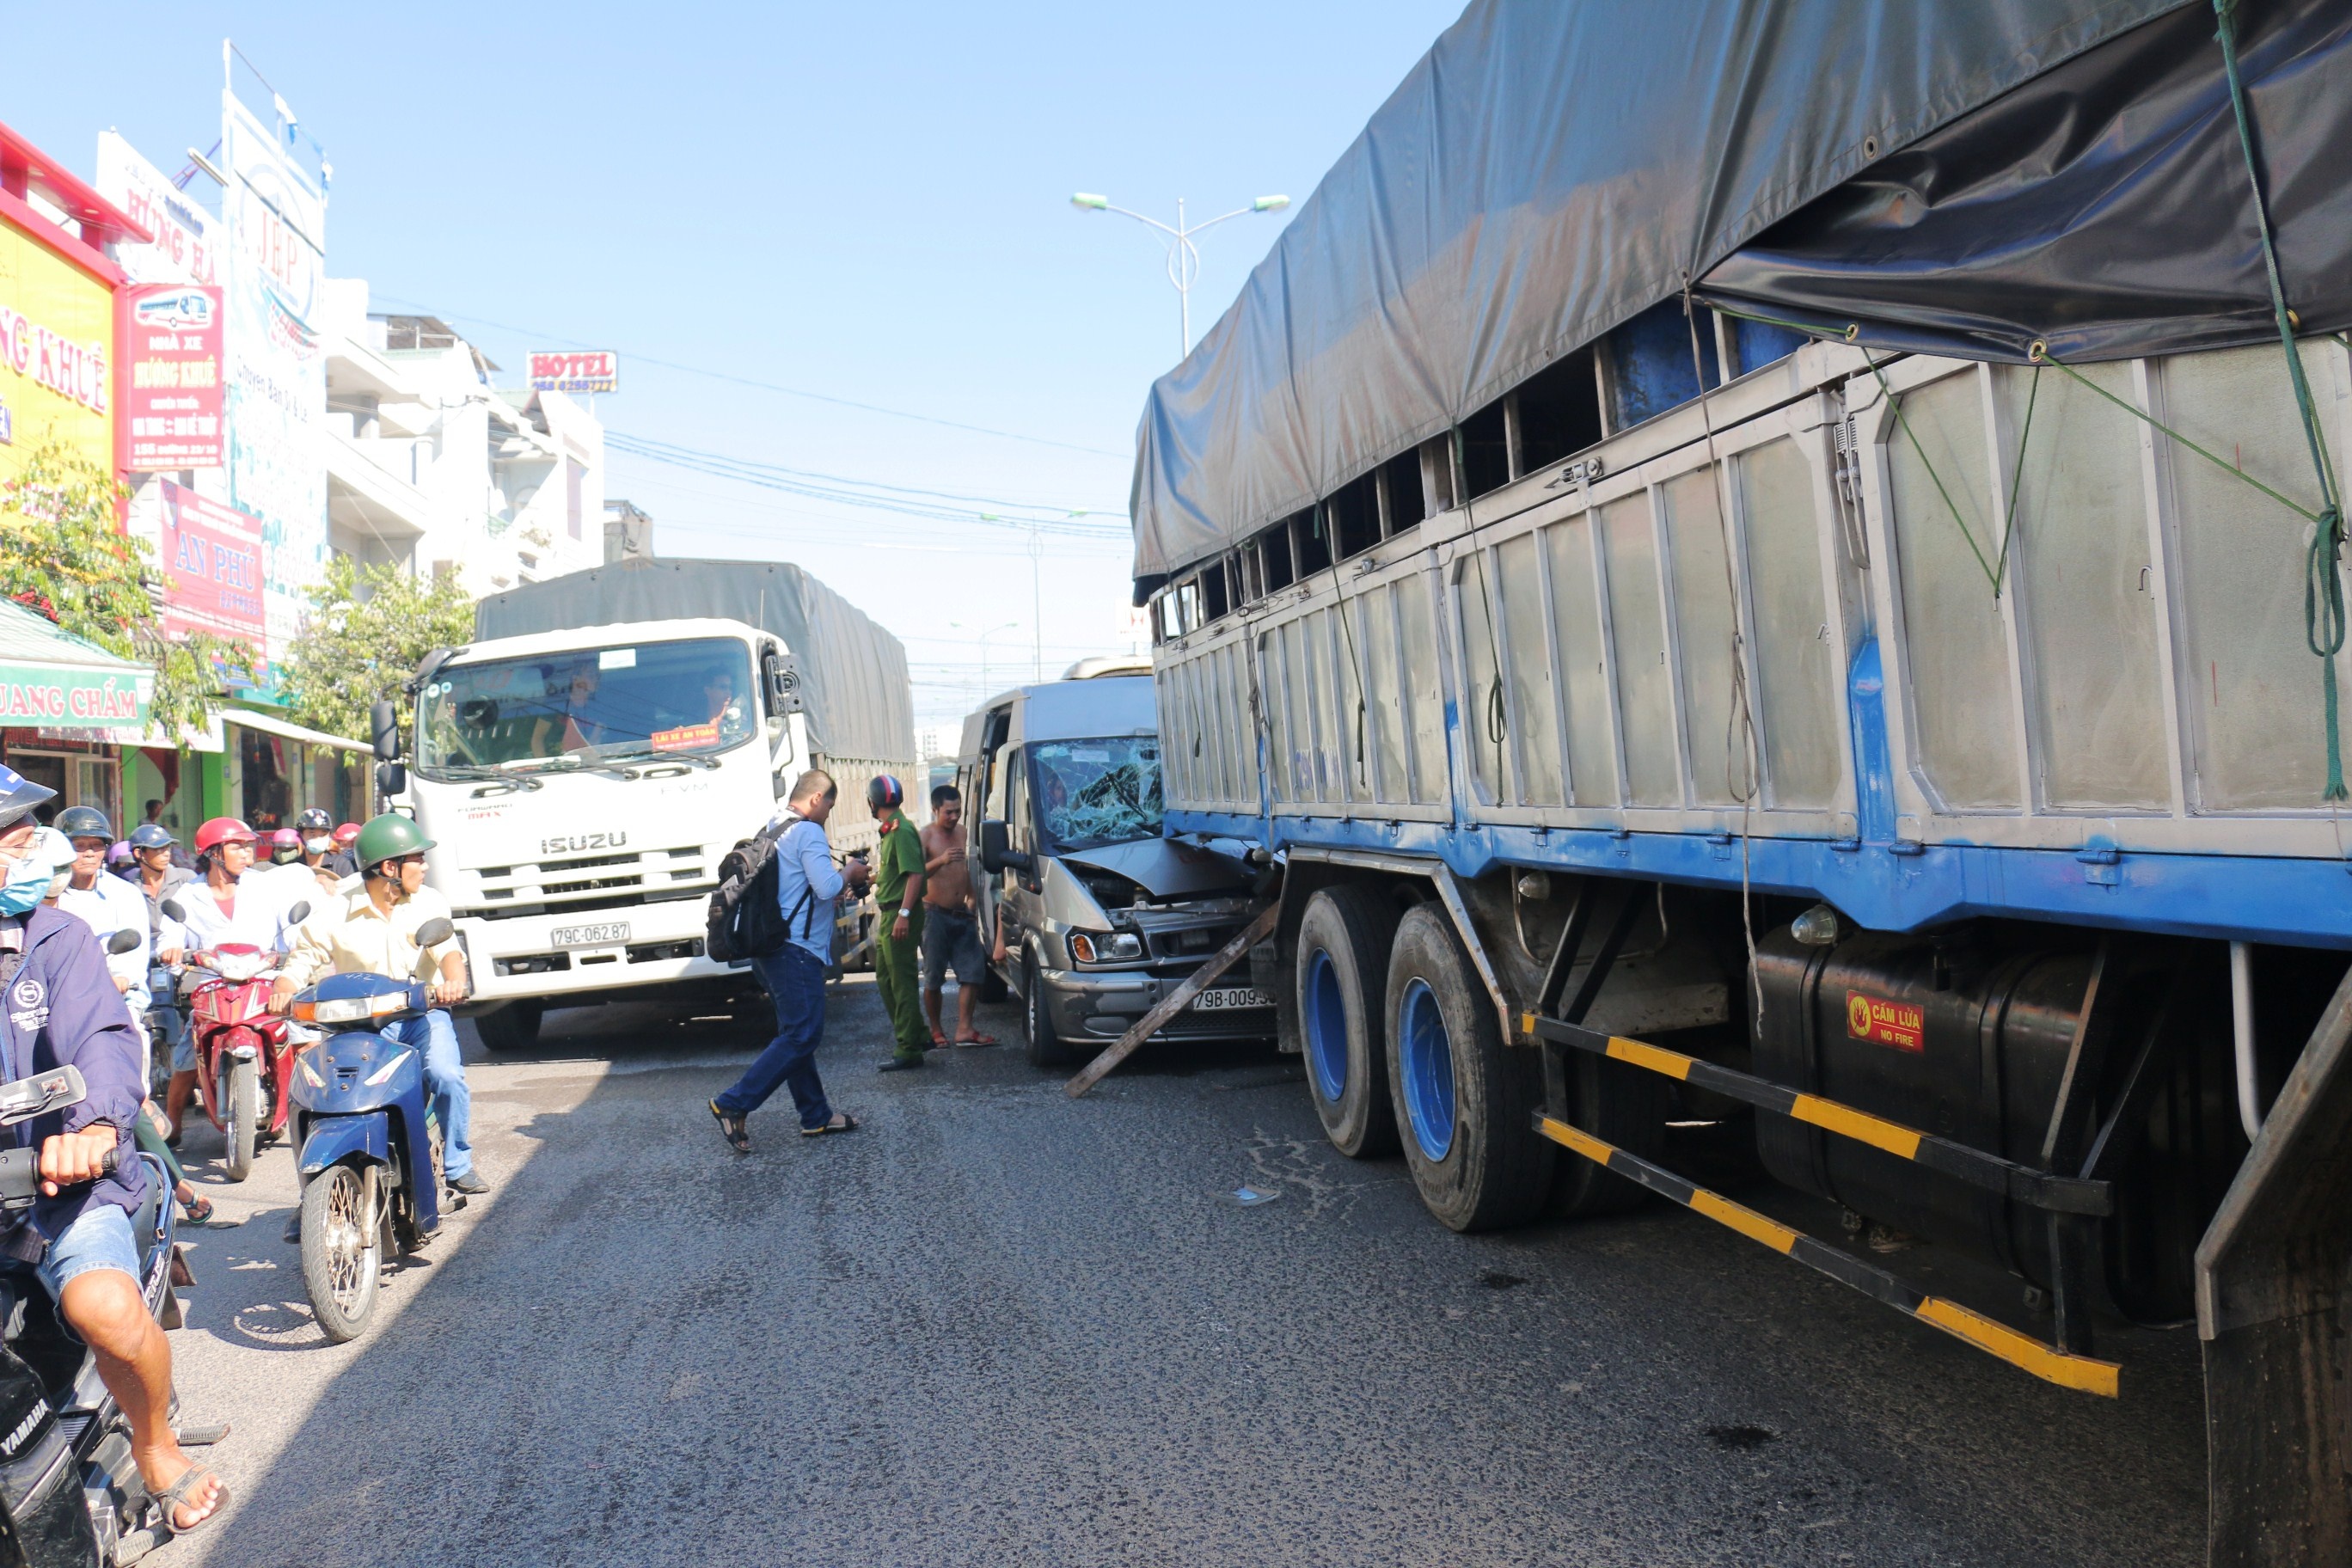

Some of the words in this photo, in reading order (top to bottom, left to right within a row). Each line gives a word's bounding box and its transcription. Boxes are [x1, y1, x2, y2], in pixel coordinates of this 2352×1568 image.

[150, 334, 180, 351] NHÀ
[184, 336, 202, 351] XE
[37, 327, 107, 413] KHUÊ
[181, 354, 216, 387] KHUÊ
[531, 353, 613, 377] HOTEL
[175, 532, 206, 576] AN
[213, 543, 255, 591] PHÚ
[69, 677, 138, 720] CHẤM
[695, 727, 715, 737] TOÀN
[541, 830, 627, 854] ISUZU
[555, 923, 627, 945] 79C-062.87
[1872, 1002, 1895, 1023] CẤM
[1899, 1007, 1920, 1030] LỬA
[1880, 1029, 1893, 1041] NO
[1895, 1033, 1914, 1047] FIRE
[0, 1398, 49, 1455] YAMAHA
